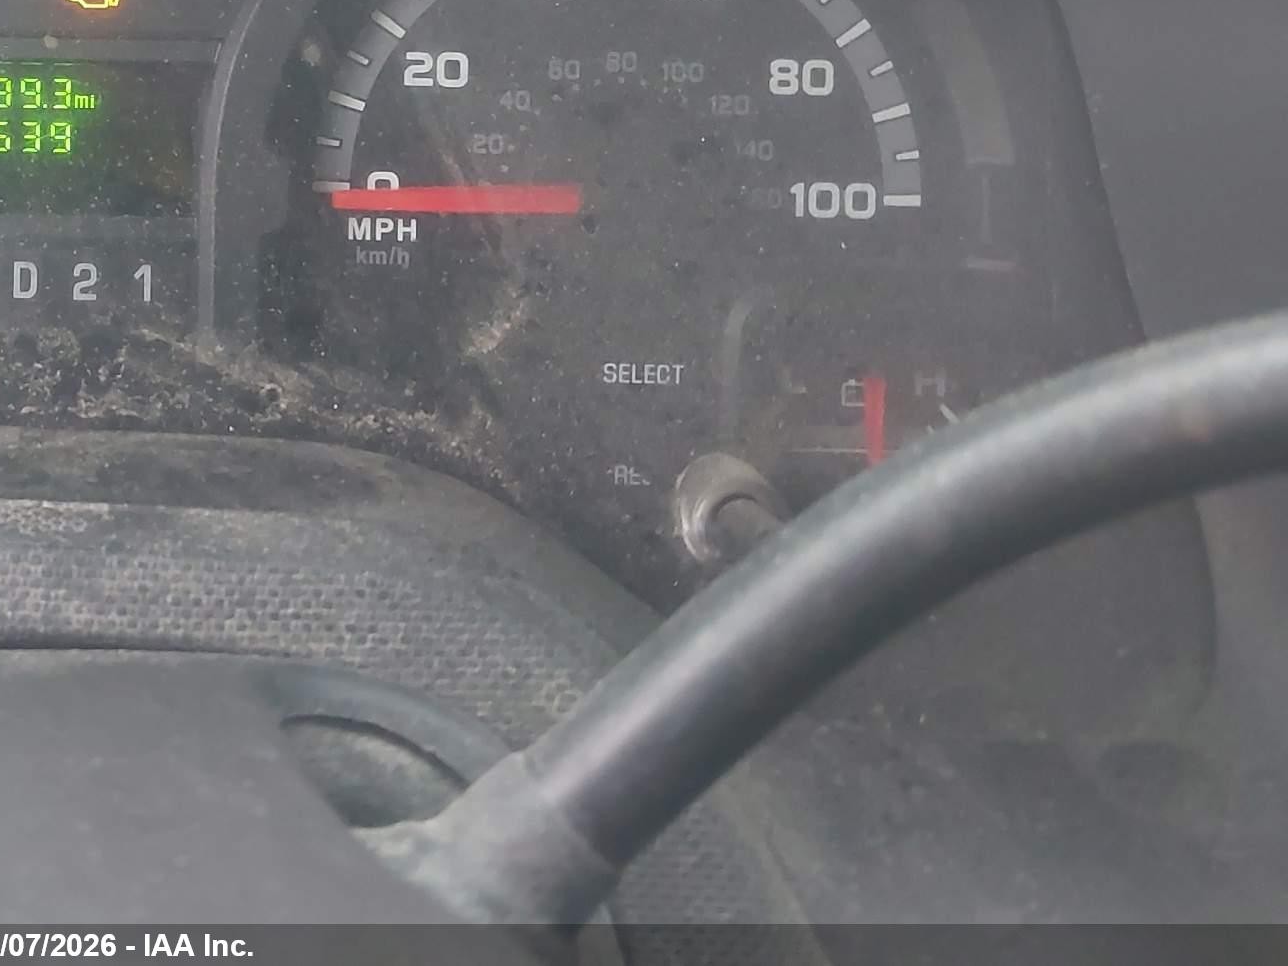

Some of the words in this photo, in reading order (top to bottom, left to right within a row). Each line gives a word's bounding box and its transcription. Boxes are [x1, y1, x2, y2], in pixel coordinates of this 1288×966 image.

[403, 51, 470, 89] 20
[769, 58, 835, 96] 80
[74, 93, 96, 110] mi
[790, 182, 877, 220] 100
[348, 217, 418, 242] MPH
[356, 245, 411, 270] km/h
[12, 261, 39, 299] D
[72, 262, 98, 301] 2
[133, 264, 153, 302] 1
[602, 362, 686, 385] SELECT
